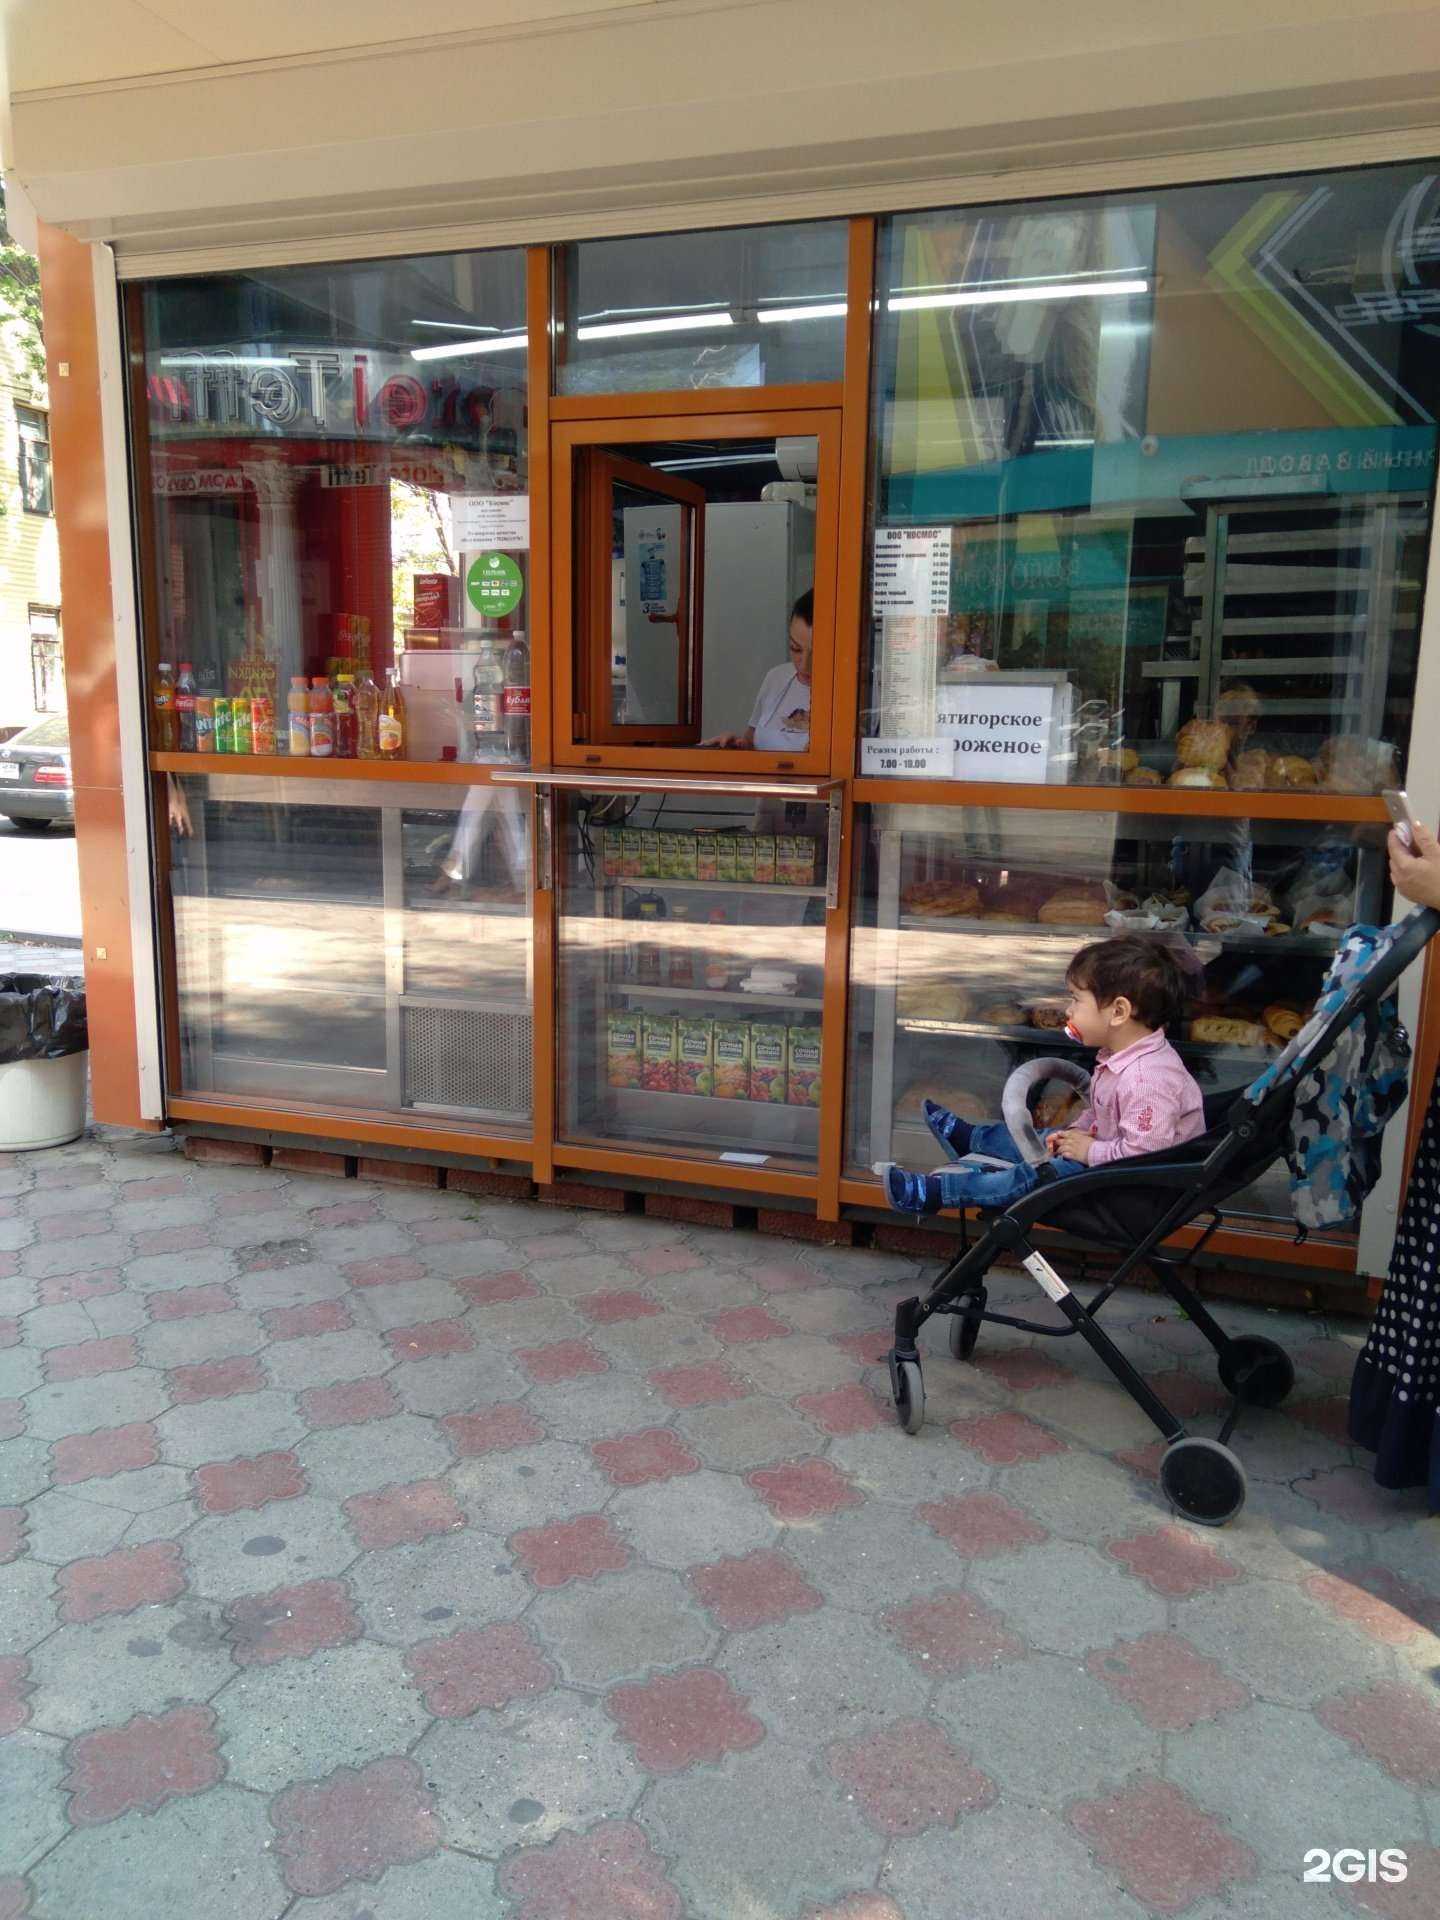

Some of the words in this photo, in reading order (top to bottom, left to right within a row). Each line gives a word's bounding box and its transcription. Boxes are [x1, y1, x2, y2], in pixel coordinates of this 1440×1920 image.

[937, 712, 1043, 730] ятигорское
[867, 745, 897, 754] Режим
[899, 745, 934, 756] работы
[880, 760, 898, 769] 7.00
